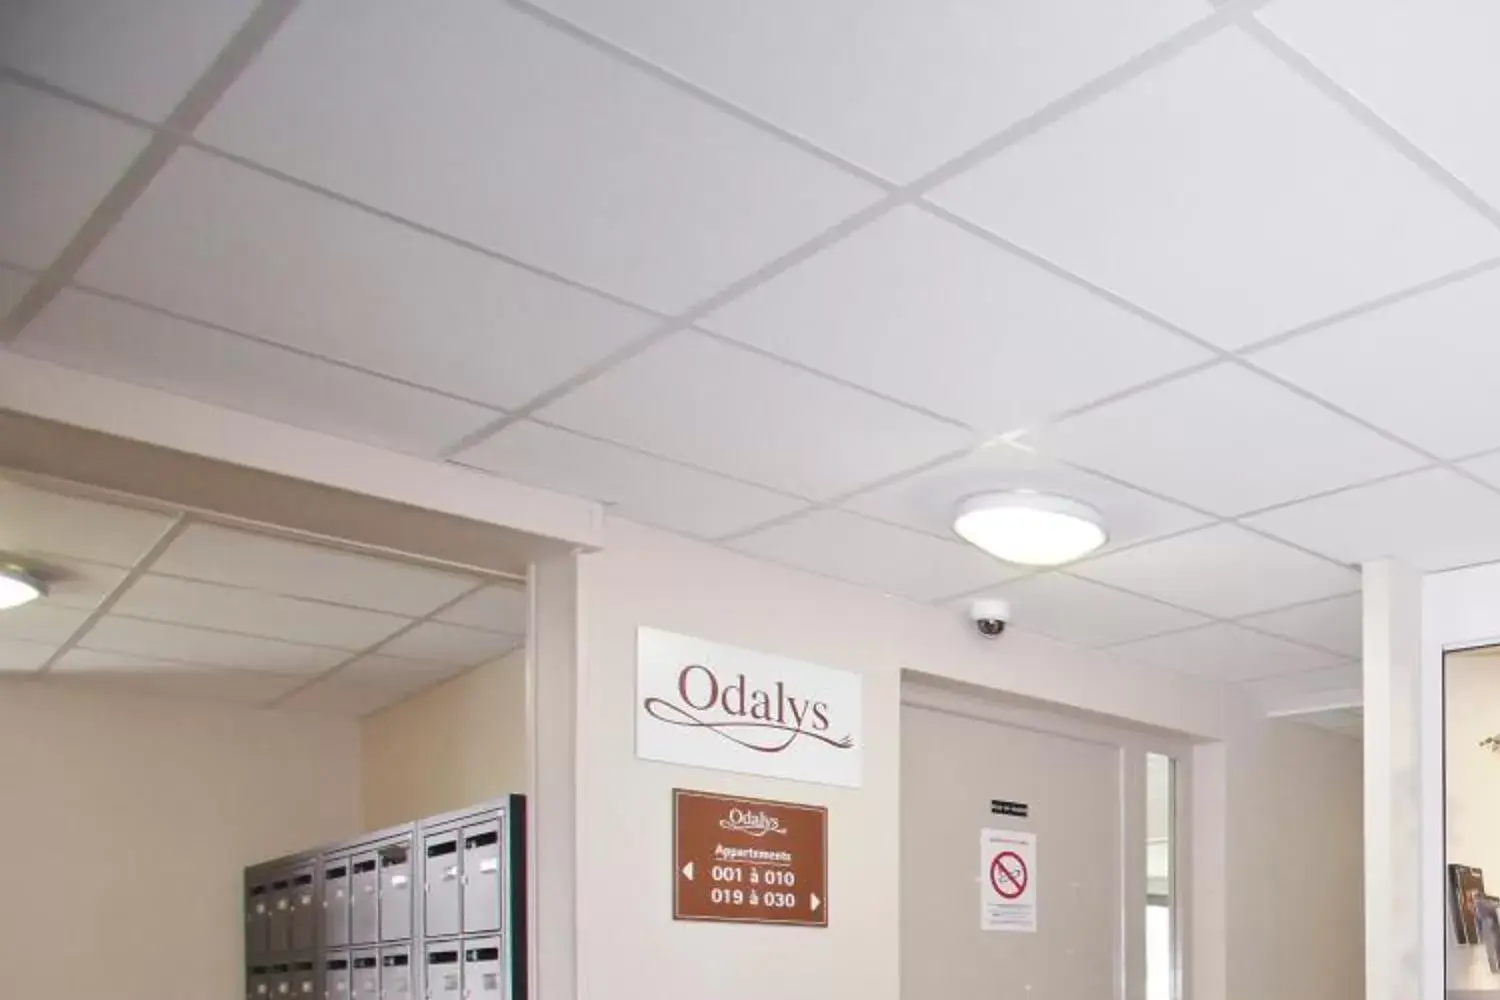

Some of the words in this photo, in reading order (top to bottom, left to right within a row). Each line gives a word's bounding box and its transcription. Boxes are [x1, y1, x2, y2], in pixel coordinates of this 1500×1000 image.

[677, 664, 831, 752] Odalys
[728, 808, 780, 836] Odalys
[714, 843, 792, 861] Appartements
[711, 866, 742, 882] 001
[749, 867, 759, 884] à
[764, 870, 795, 887] 010
[711, 887, 743, 905] 019
[749, 888, 759, 905] à
[763, 891, 795, 908] 030
